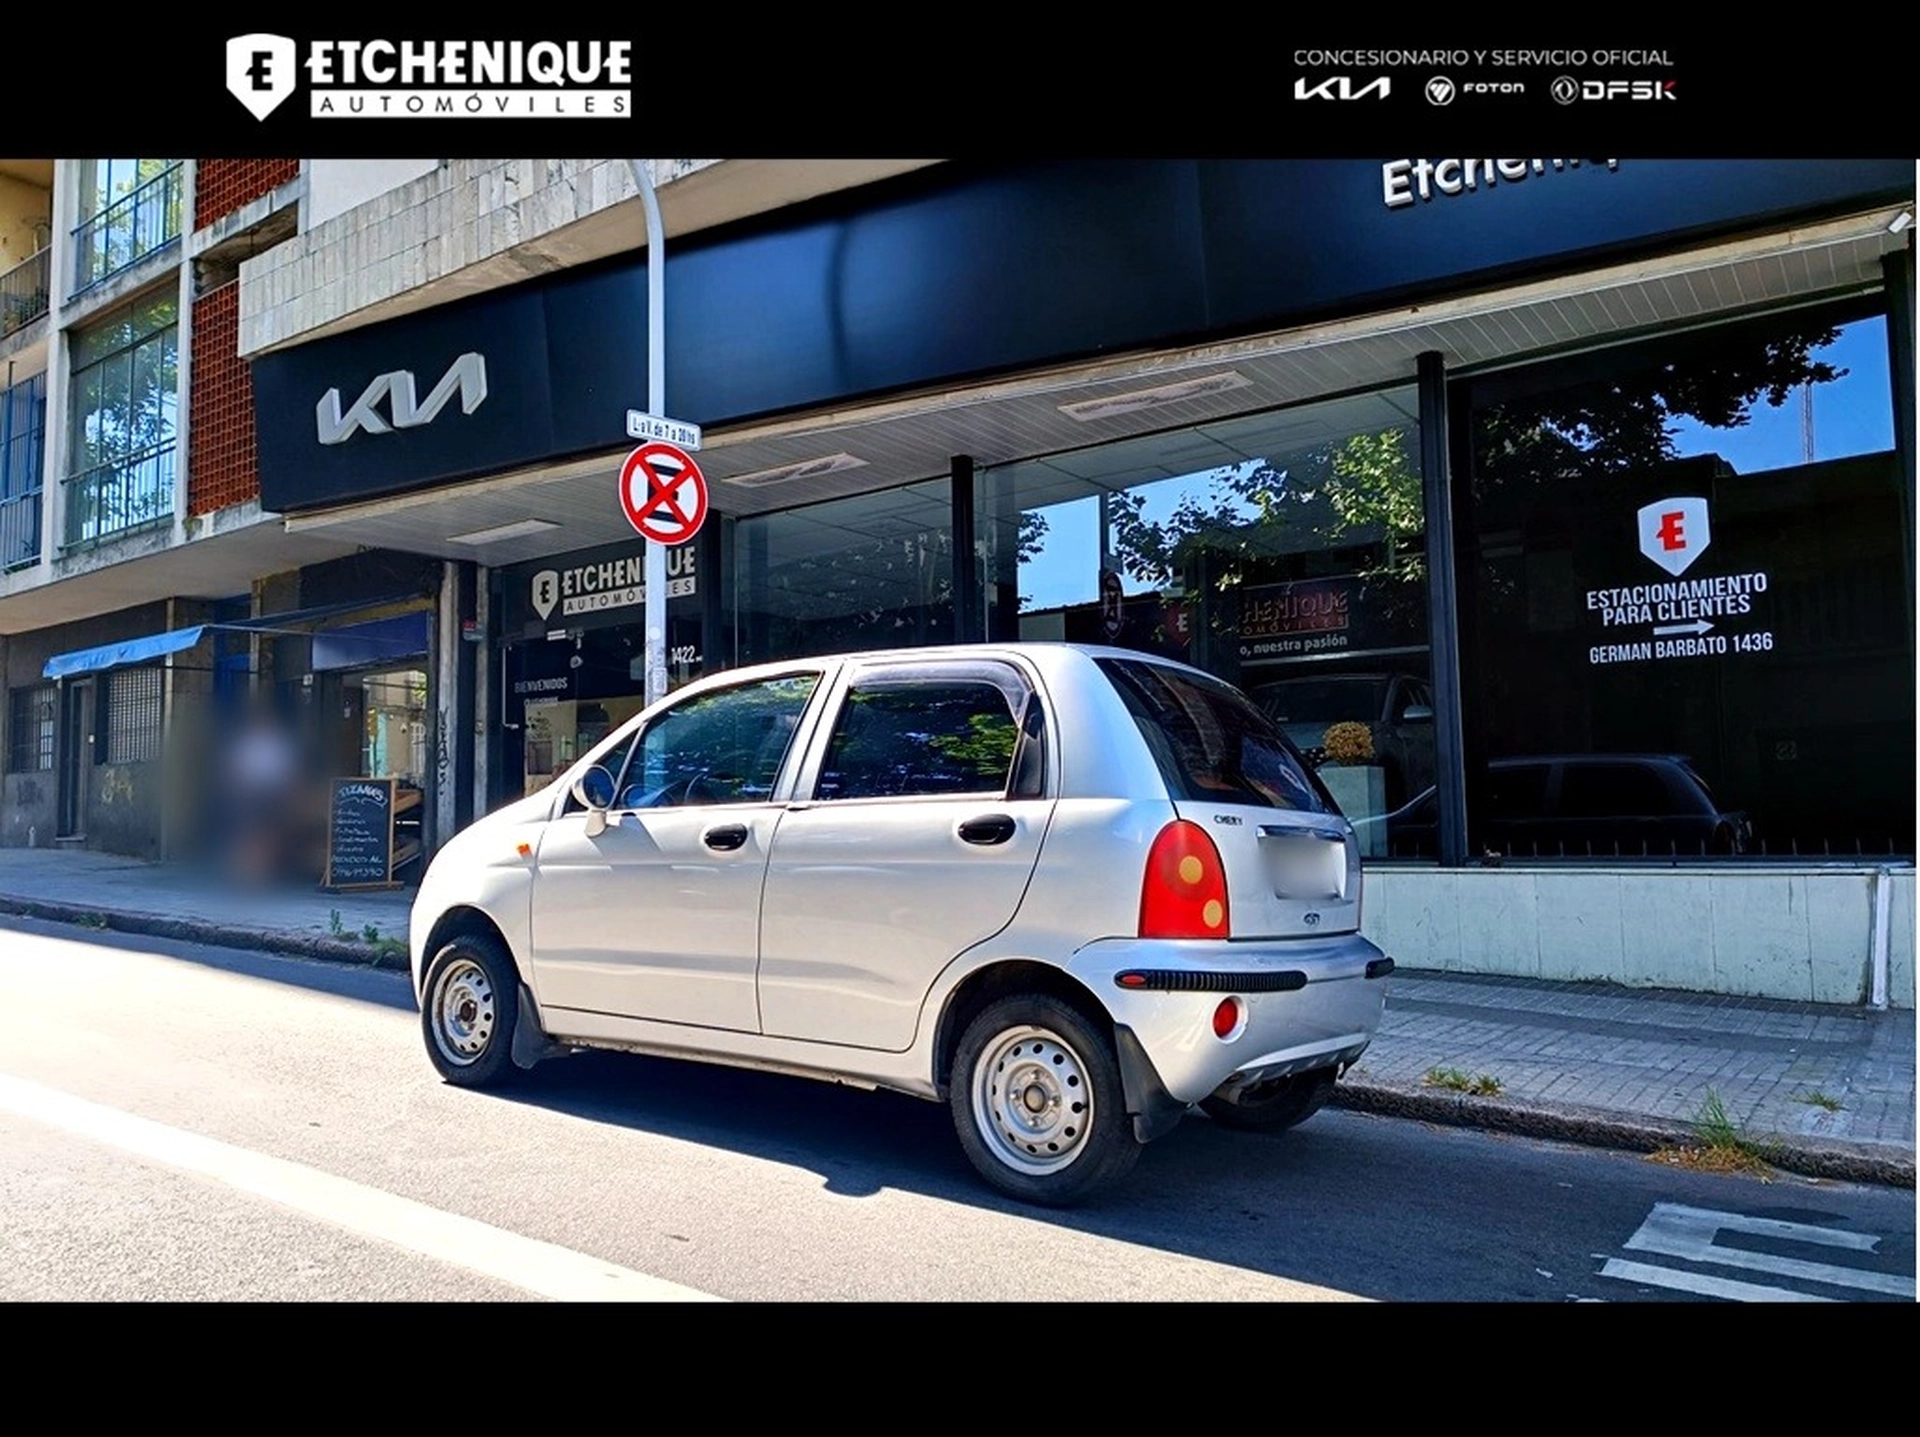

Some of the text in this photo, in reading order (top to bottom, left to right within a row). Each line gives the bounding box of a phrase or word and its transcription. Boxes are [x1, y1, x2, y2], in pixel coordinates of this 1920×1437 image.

[316, 351, 488, 445] KIA
[1656, 511, 1686, 551] E
[566, 580, 692, 612] AUTOMÓVES
[1586, 573, 1767, 610] ESTACIONAMIENTO
[1603, 595, 1751, 626] PARA CLIENTES
[1254, 640, 1301, 654] nuestra
[1304, 634, 1348, 652] pasión
[1590, 633, 1773, 664] GERMAN BARBATO 1436
[1214, 815, 1242, 825] CHERY
